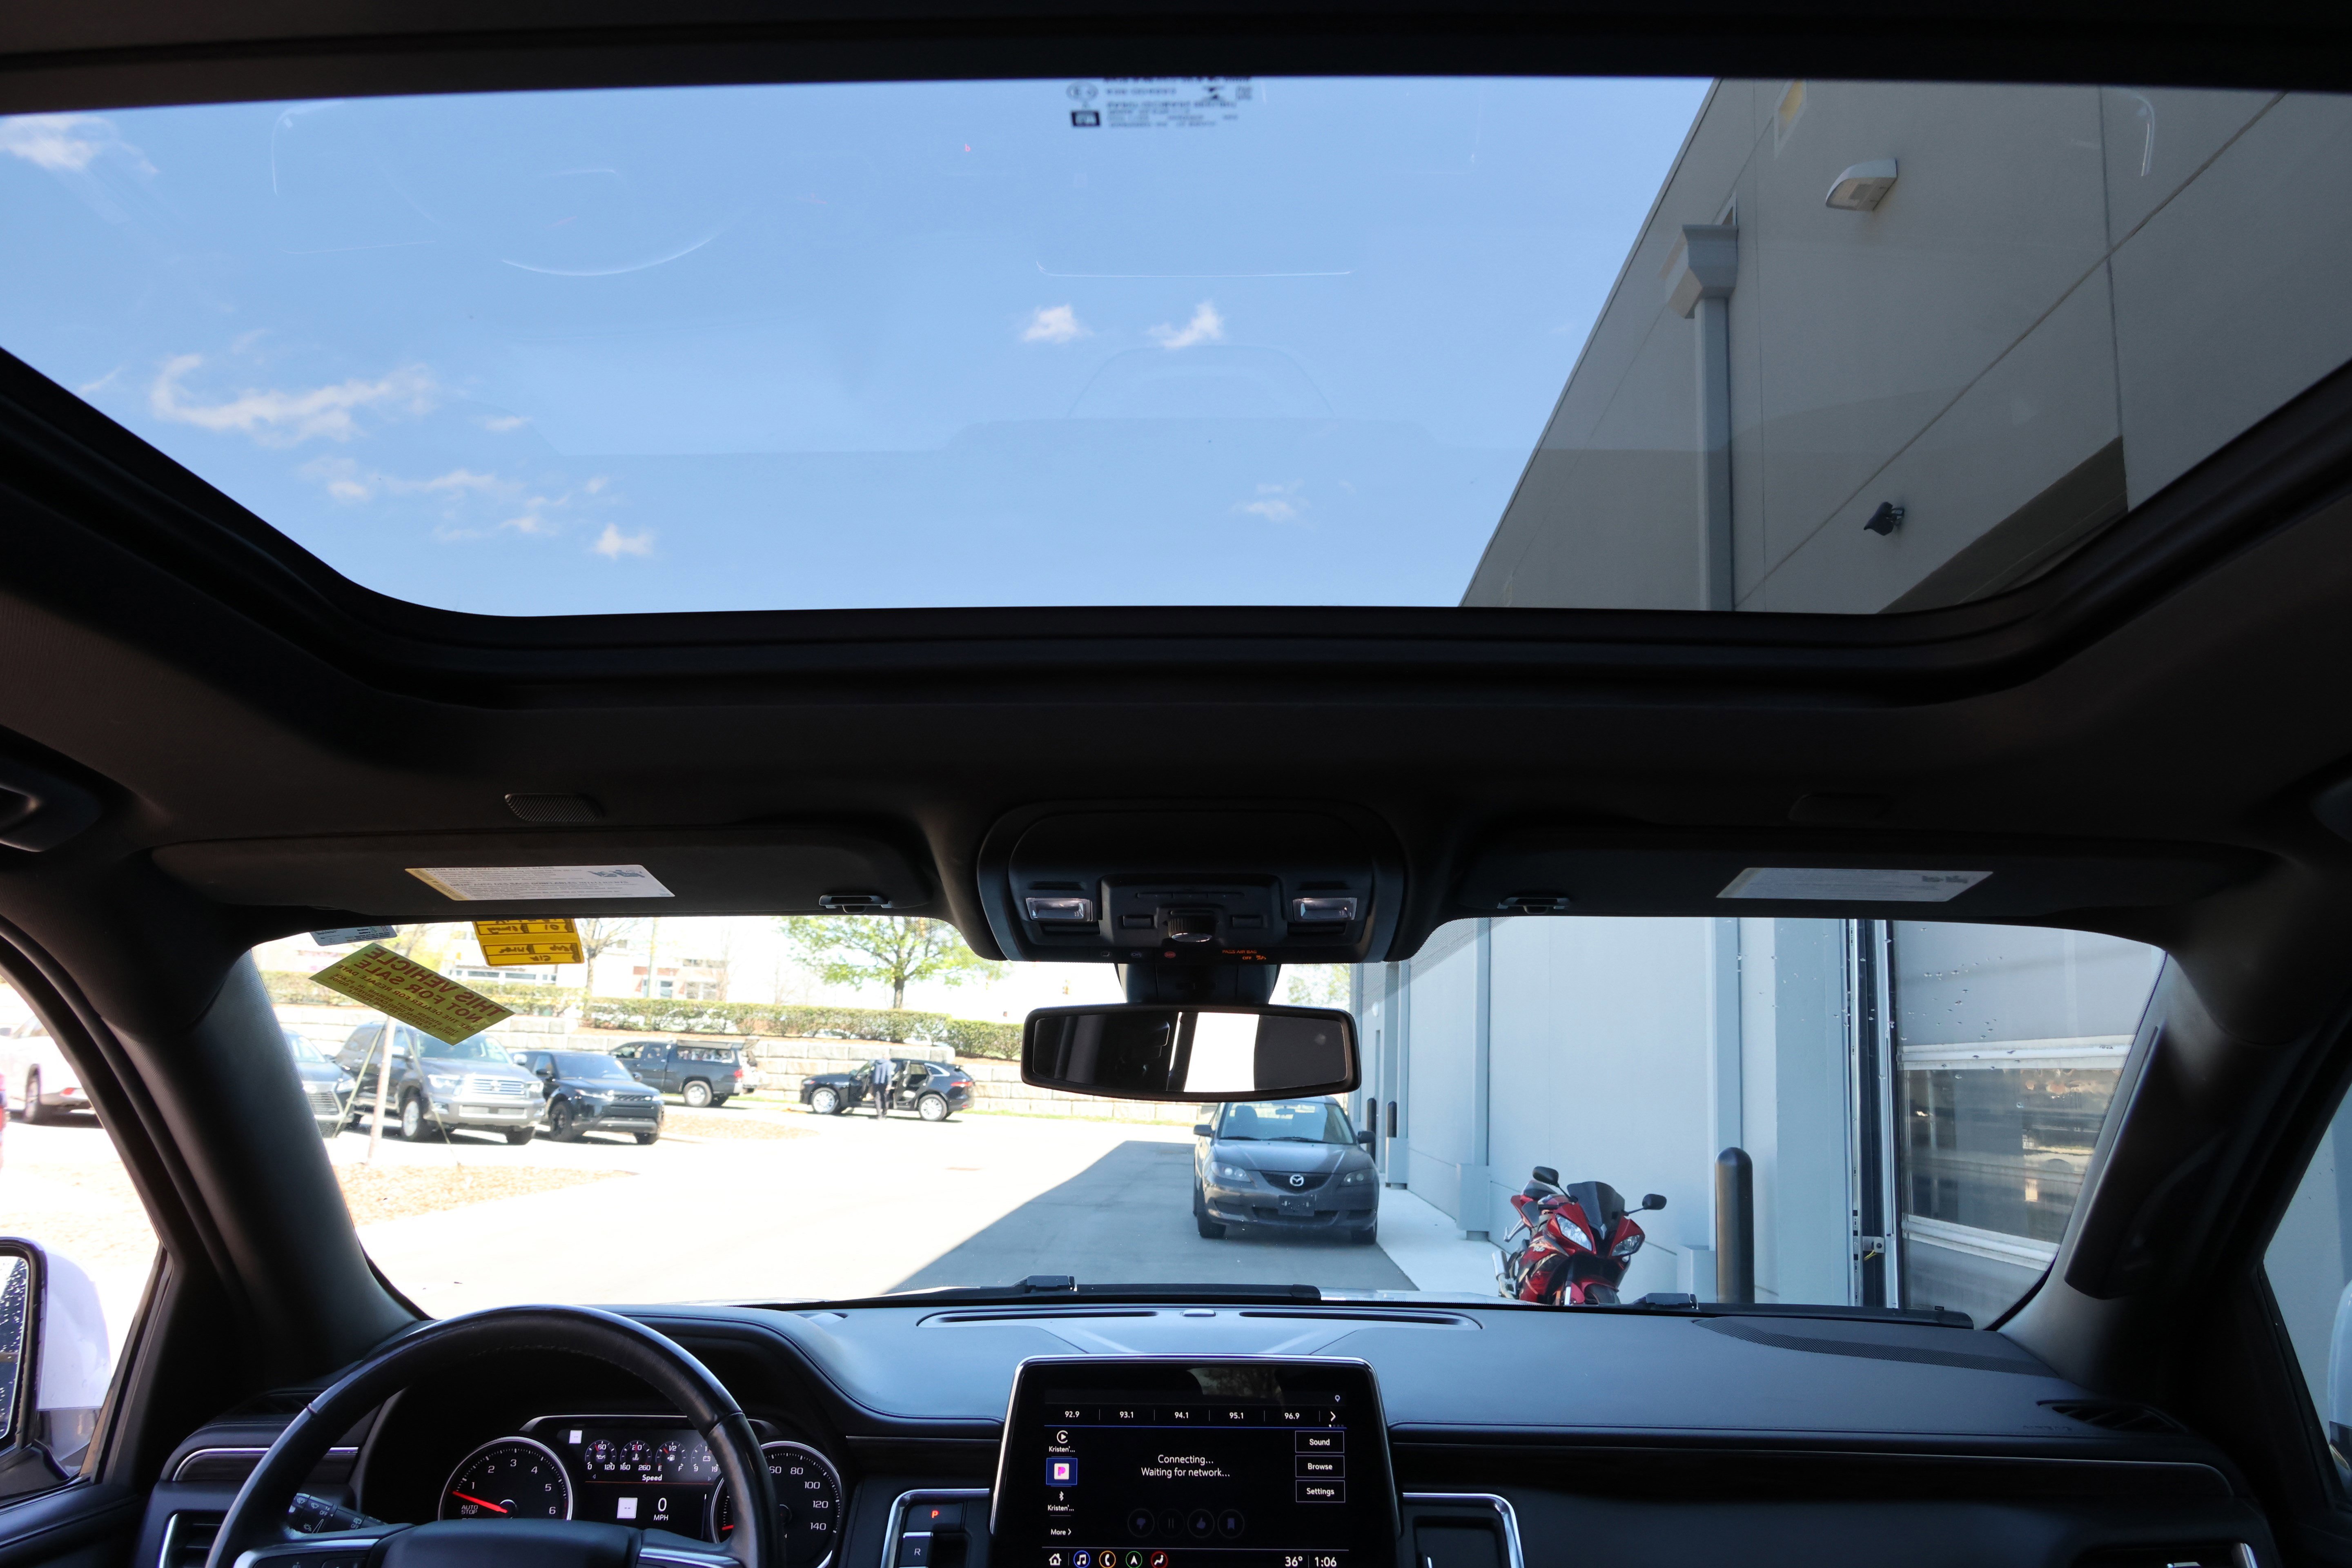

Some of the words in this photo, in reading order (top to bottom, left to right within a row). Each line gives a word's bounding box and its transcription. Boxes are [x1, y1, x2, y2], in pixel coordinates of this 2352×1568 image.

[1158, 1454, 1214, 1466] Connecting...
[1141, 1467, 1172, 1479] Waiting
[1174, 1467, 1186, 1477] for
[1188, 1467, 1230, 1477] network...
[642, 1474, 662, 1483] Speed
[1307, 1488, 1334, 1496] Settings
[658, 1497, 667, 1512] 0
[813, 1500, 829, 1508] 120
[549, 1506, 556, 1515] 6
[931, 1510, 940, 1518] P
[810, 1522, 826, 1530] 140
[1285, 1556, 1303, 1567] 36°
[1314, 1557, 1337, 1567] 1:06
